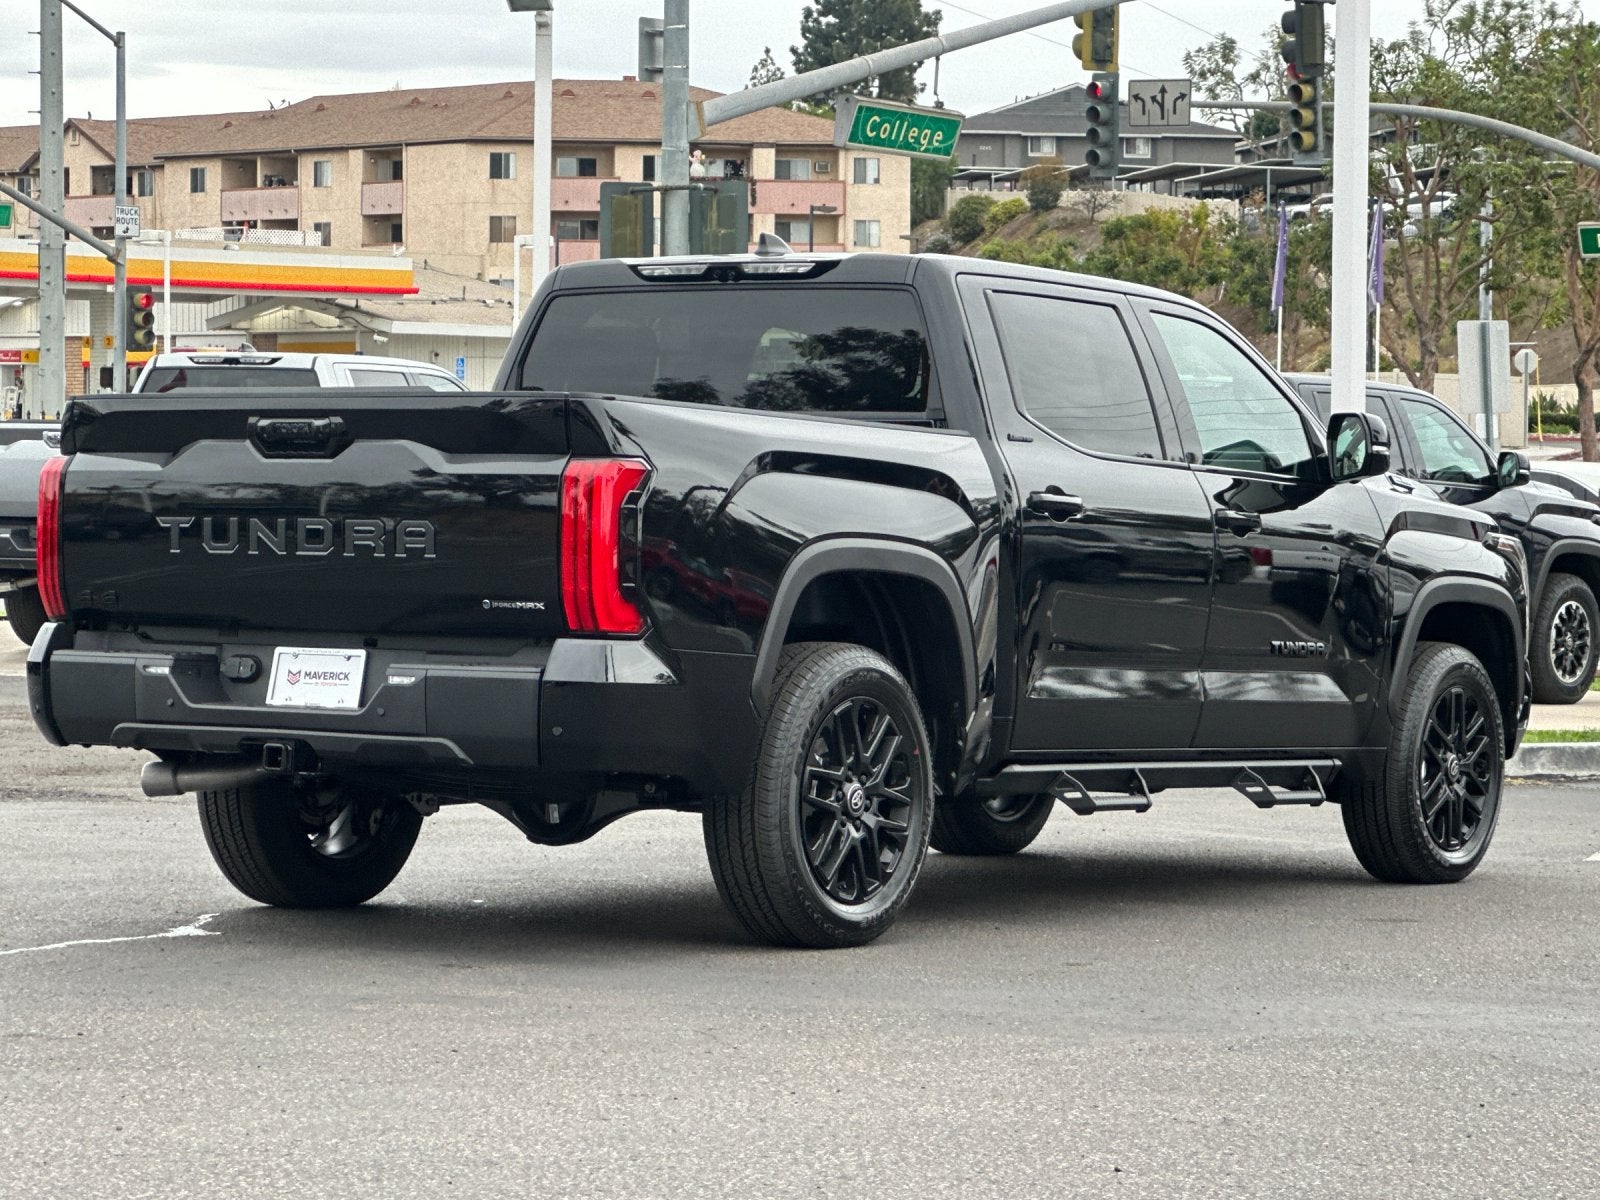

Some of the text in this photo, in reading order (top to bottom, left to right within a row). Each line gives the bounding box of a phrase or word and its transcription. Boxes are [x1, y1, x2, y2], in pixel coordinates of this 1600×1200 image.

[866, 115, 943, 151] College
[116, 207, 139, 216] TRUCK
[116, 217, 139, 225] ROUTE
[155, 516, 436, 558] TUNDRA
[1271, 640, 1326, 656] TUNDRA
[304, 671, 350, 680] MAVERICK
